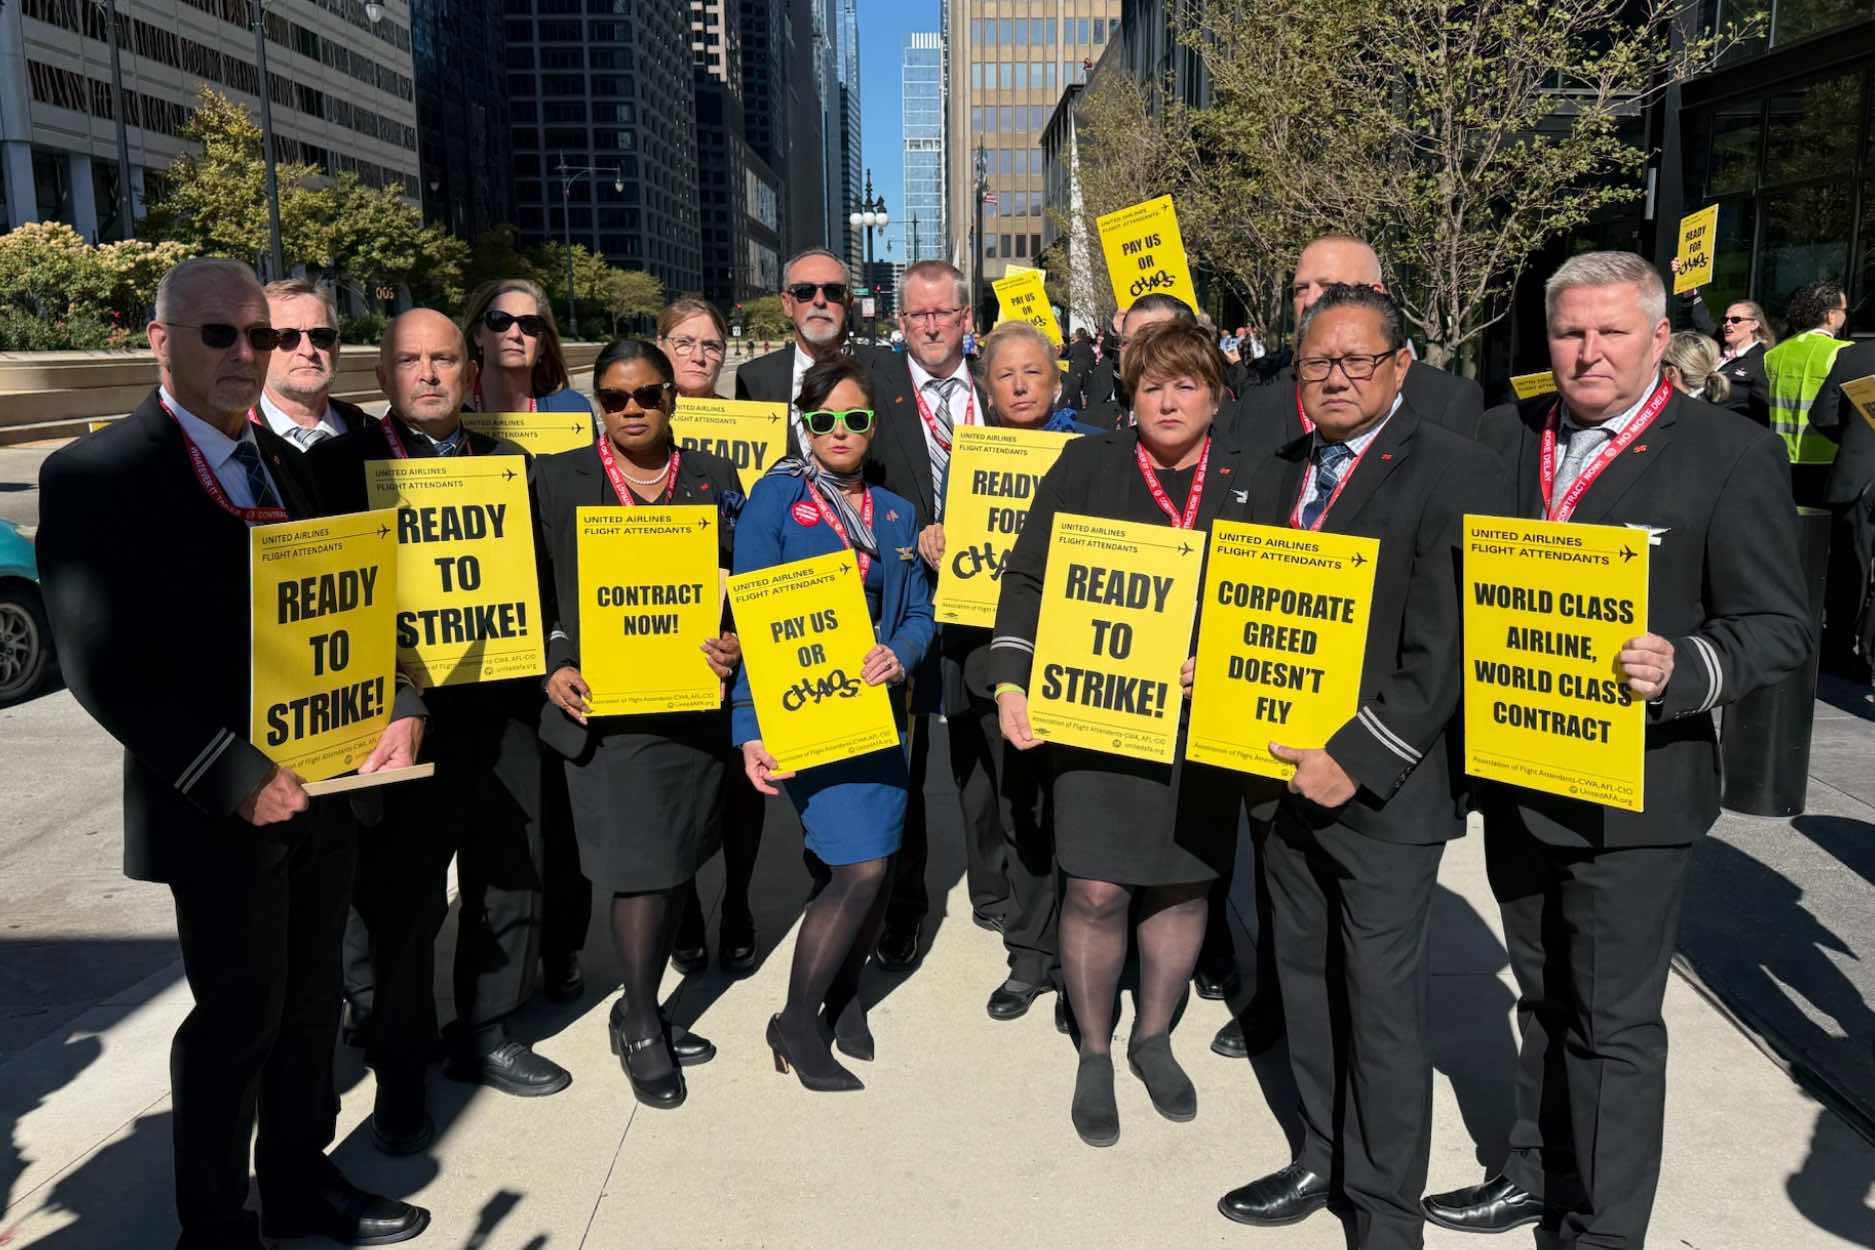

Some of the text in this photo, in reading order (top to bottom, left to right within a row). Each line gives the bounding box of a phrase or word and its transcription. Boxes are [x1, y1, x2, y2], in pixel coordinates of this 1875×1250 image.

[1122, 233, 1162, 256] PAY US
[1685, 224, 1707, 242] READY
[1689, 241, 1702, 253] FOR
[1137, 255, 1155, 270] OR
[1130, 270, 1176, 297] CHAOS
[1025, 292, 1036, 302] US
[694, 417, 737, 425] ATTENDANTS
[697, 405, 725, 413] AIRLINES
[1616, 432, 1632, 446] NO
[1630, 410, 1654, 433] MORE
[1651, 385, 1670, 410] DELA
[960, 444, 1028, 456] FLIGHT ATTENDANTS
[961, 432, 1016, 443] UNITED AIRLINES
[375, 467, 447, 478] UNITED AIRLINES
[1544, 455, 1552, 481] DELAY
[376, 480, 464, 491] FLIGHT ATTENDANTS
[972, 470, 1043, 499] READY
[398, 504, 507, 544] READY
[584, 515, 672, 524] UNITED AIRLINES
[584, 526, 692, 535] FLIGHT ATTENDANTS
[988, 507, 1030, 534] FOR
[1061, 523, 1126, 538] UNITED AIRLINES
[262, 528, 329, 545] UNITED AIRLINES
[1059, 536, 1138, 553] FLIGHT ATTENDANTS
[1219, 532, 1319, 552] UNITED AIRLINES
[1471, 529, 1583, 547] UNITED AIRLINES
[262, 542, 343, 562] FLIGHT ATTENDANTS
[1217, 545, 1342, 570] FLIGHT ATTENDANTS
[1471, 543, 1610, 565] FLIGHT ATTENDANTS
[434, 555, 481, 593] TO
[733, 568, 815, 592] UNITED AIRLINES
[278, 565, 378, 624] READY
[597, 584, 703, 607] CONTRACT
[736, 574, 836, 603] FLIGHT ATTENDANTS
[1065, 563, 1175, 613] READY
[1218, 580, 1356, 624] CORPORATE
[1474, 582, 1634, 625] WORLD CLASS
[396, 602, 527, 648] STRIKE!
[624, 614, 679, 636] NOW!
[770, 609, 839, 643] PAY US
[1091, 619, 1133, 660] TO
[1243, 621, 1317, 655] GREED
[1506, 626, 1597, 662] AIRLINE,
[309, 629, 349, 676] TO
[798, 643, 826, 667] OR
[1228, 655, 1325, 693] DOESN'T
[1474, 660, 1633, 707] WORLD CLASS
[783, 669, 861, 711] CHAOS
[1042, 663, 1168, 718] STRIKE!
[267, 676, 384, 746] STRIKE!
[1256, 697, 1292, 725] FLY
[1493, 701, 1612, 744] CONTRACT
